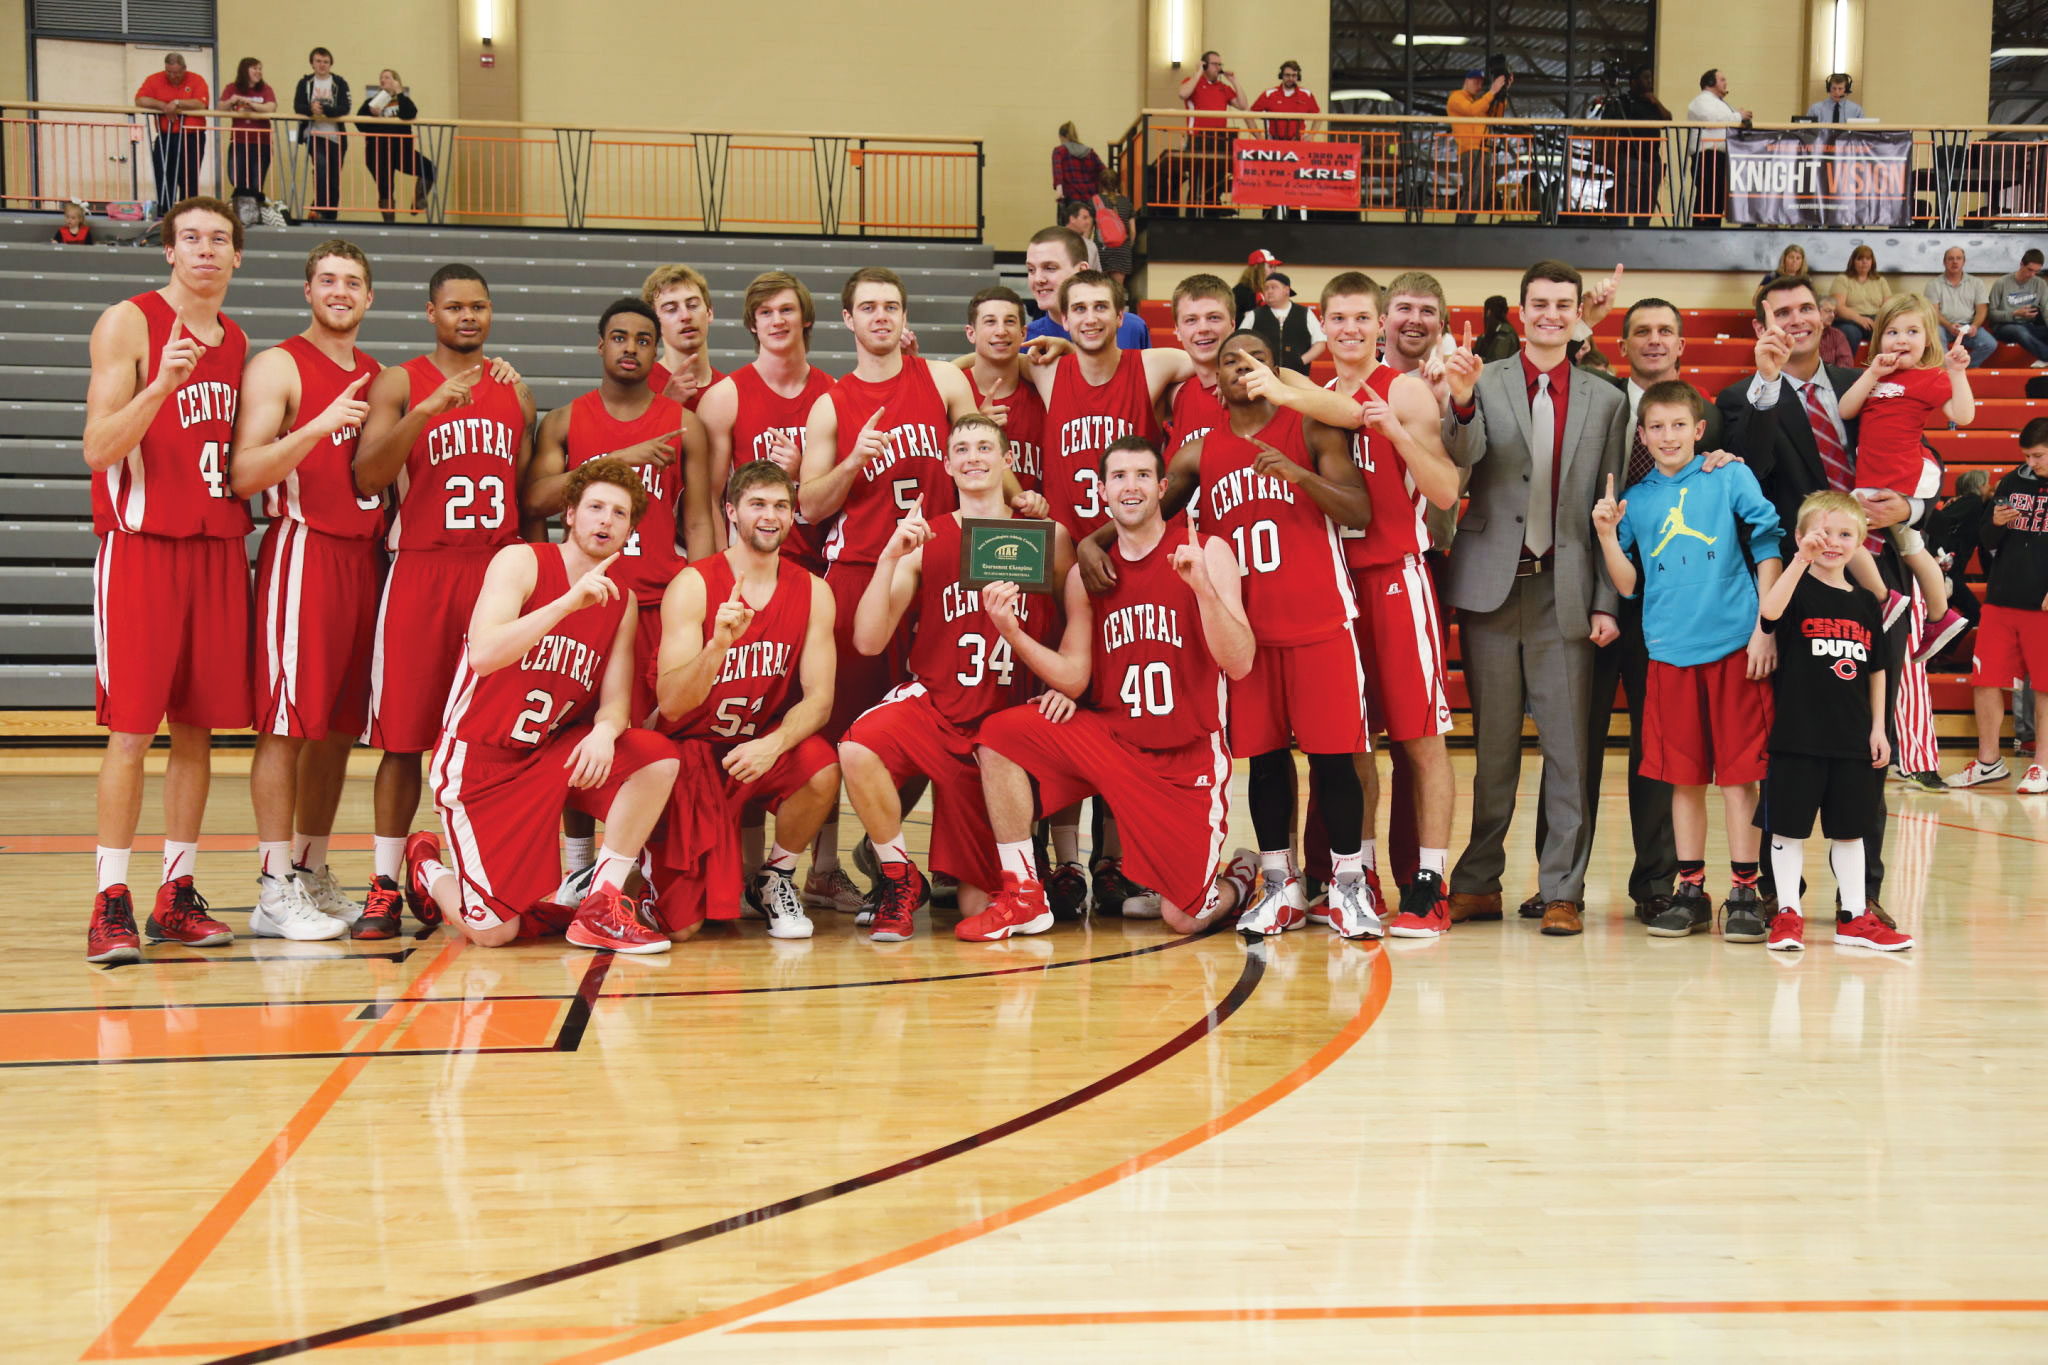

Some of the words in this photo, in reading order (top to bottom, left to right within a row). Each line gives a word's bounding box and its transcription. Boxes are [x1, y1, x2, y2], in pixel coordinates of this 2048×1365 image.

[1240, 149, 1299, 162] KNIA
[1297, 167, 1357, 181] KRLS
[1730, 159, 1821, 193] KNIGHT
[1826, 161, 1906, 194] VISION
[177, 381, 237, 429] CENTR
[428, 418, 513, 466] CENTRAL
[445, 475, 505, 529] 23
[1074, 469, 1114, 518] 3
[1232, 520, 1281, 577] 10
[1658, 551, 1716, 572] AIR
[943, 581, 1028, 622] CENAL
[1104, 604, 1182, 654] CENTRAL
[713, 641, 790, 685] ENTRAL
[957, 633, 1014, 686] 34
[1120, 661, 1175, 718] 40
